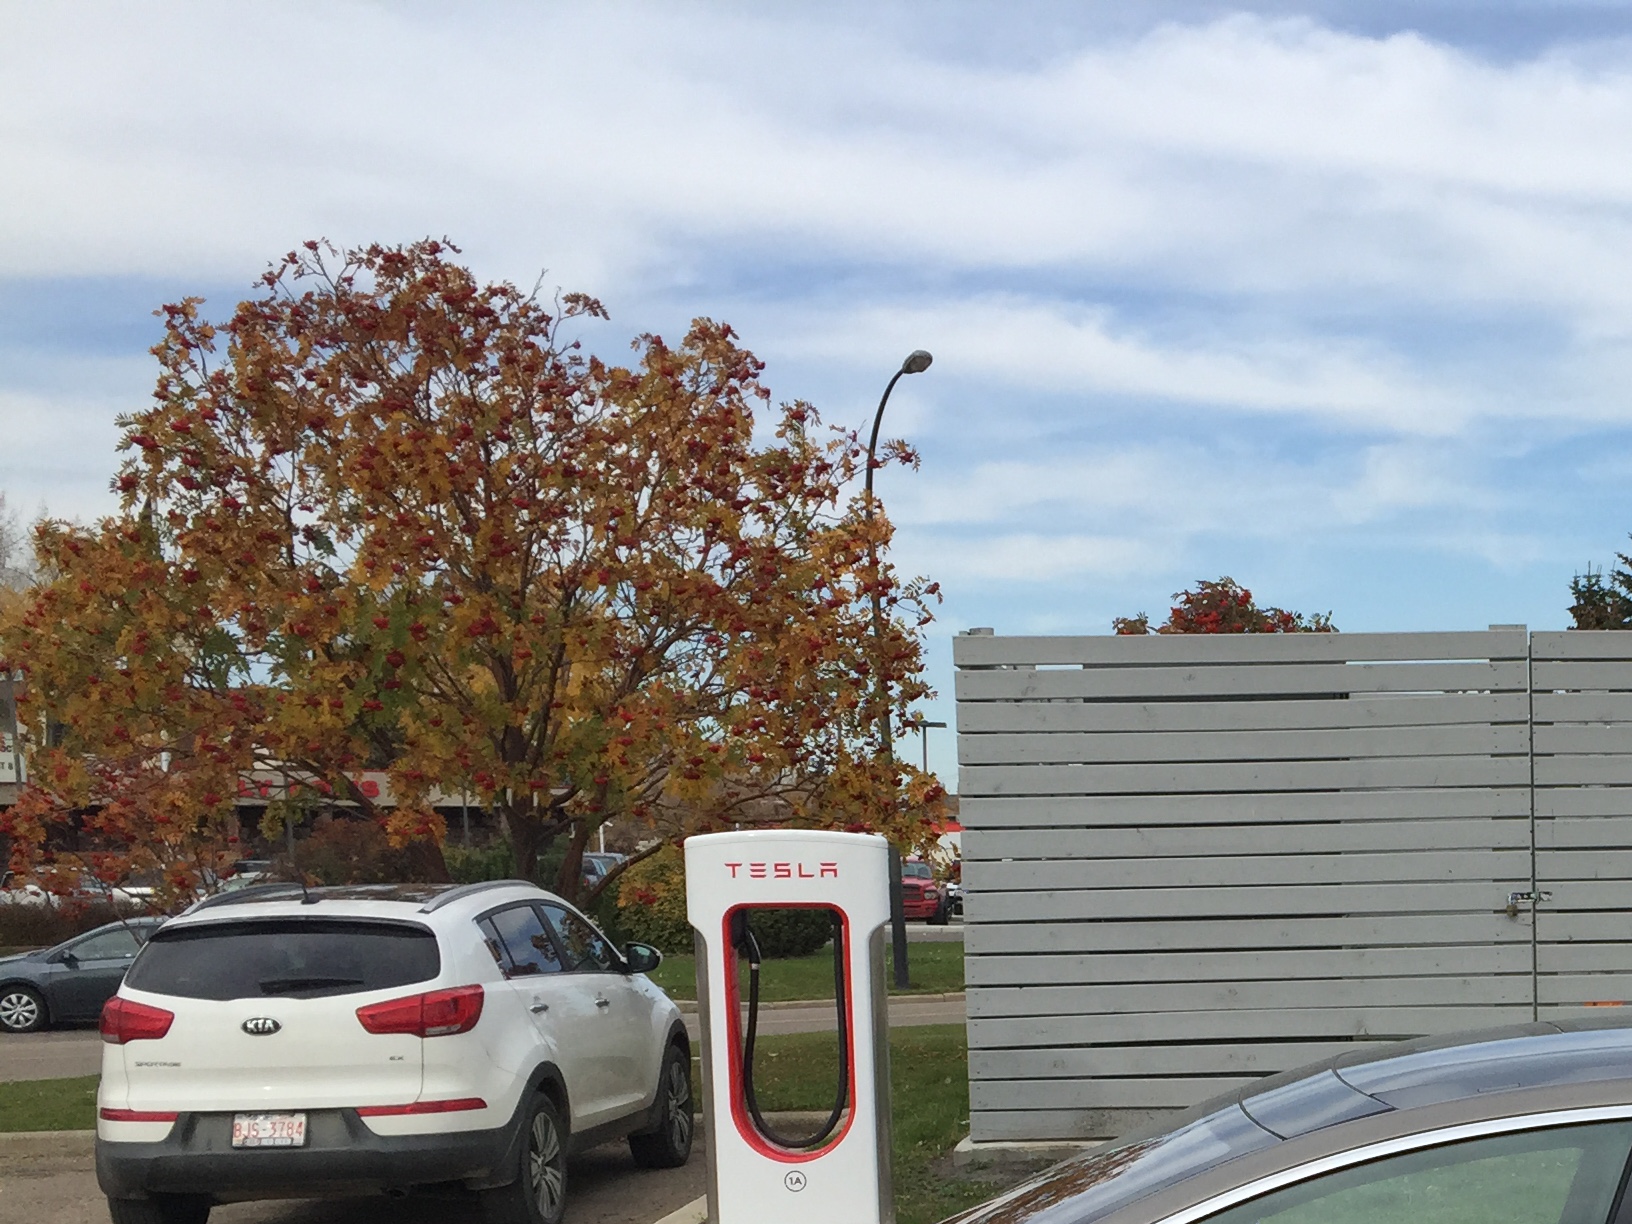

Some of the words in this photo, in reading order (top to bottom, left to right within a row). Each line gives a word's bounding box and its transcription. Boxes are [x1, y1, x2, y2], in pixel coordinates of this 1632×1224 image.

[723, 862, 838, 879] TESLA
[246, 1019, 275, 1032] KIA
[788, 1176, 803, 1186] 1A
